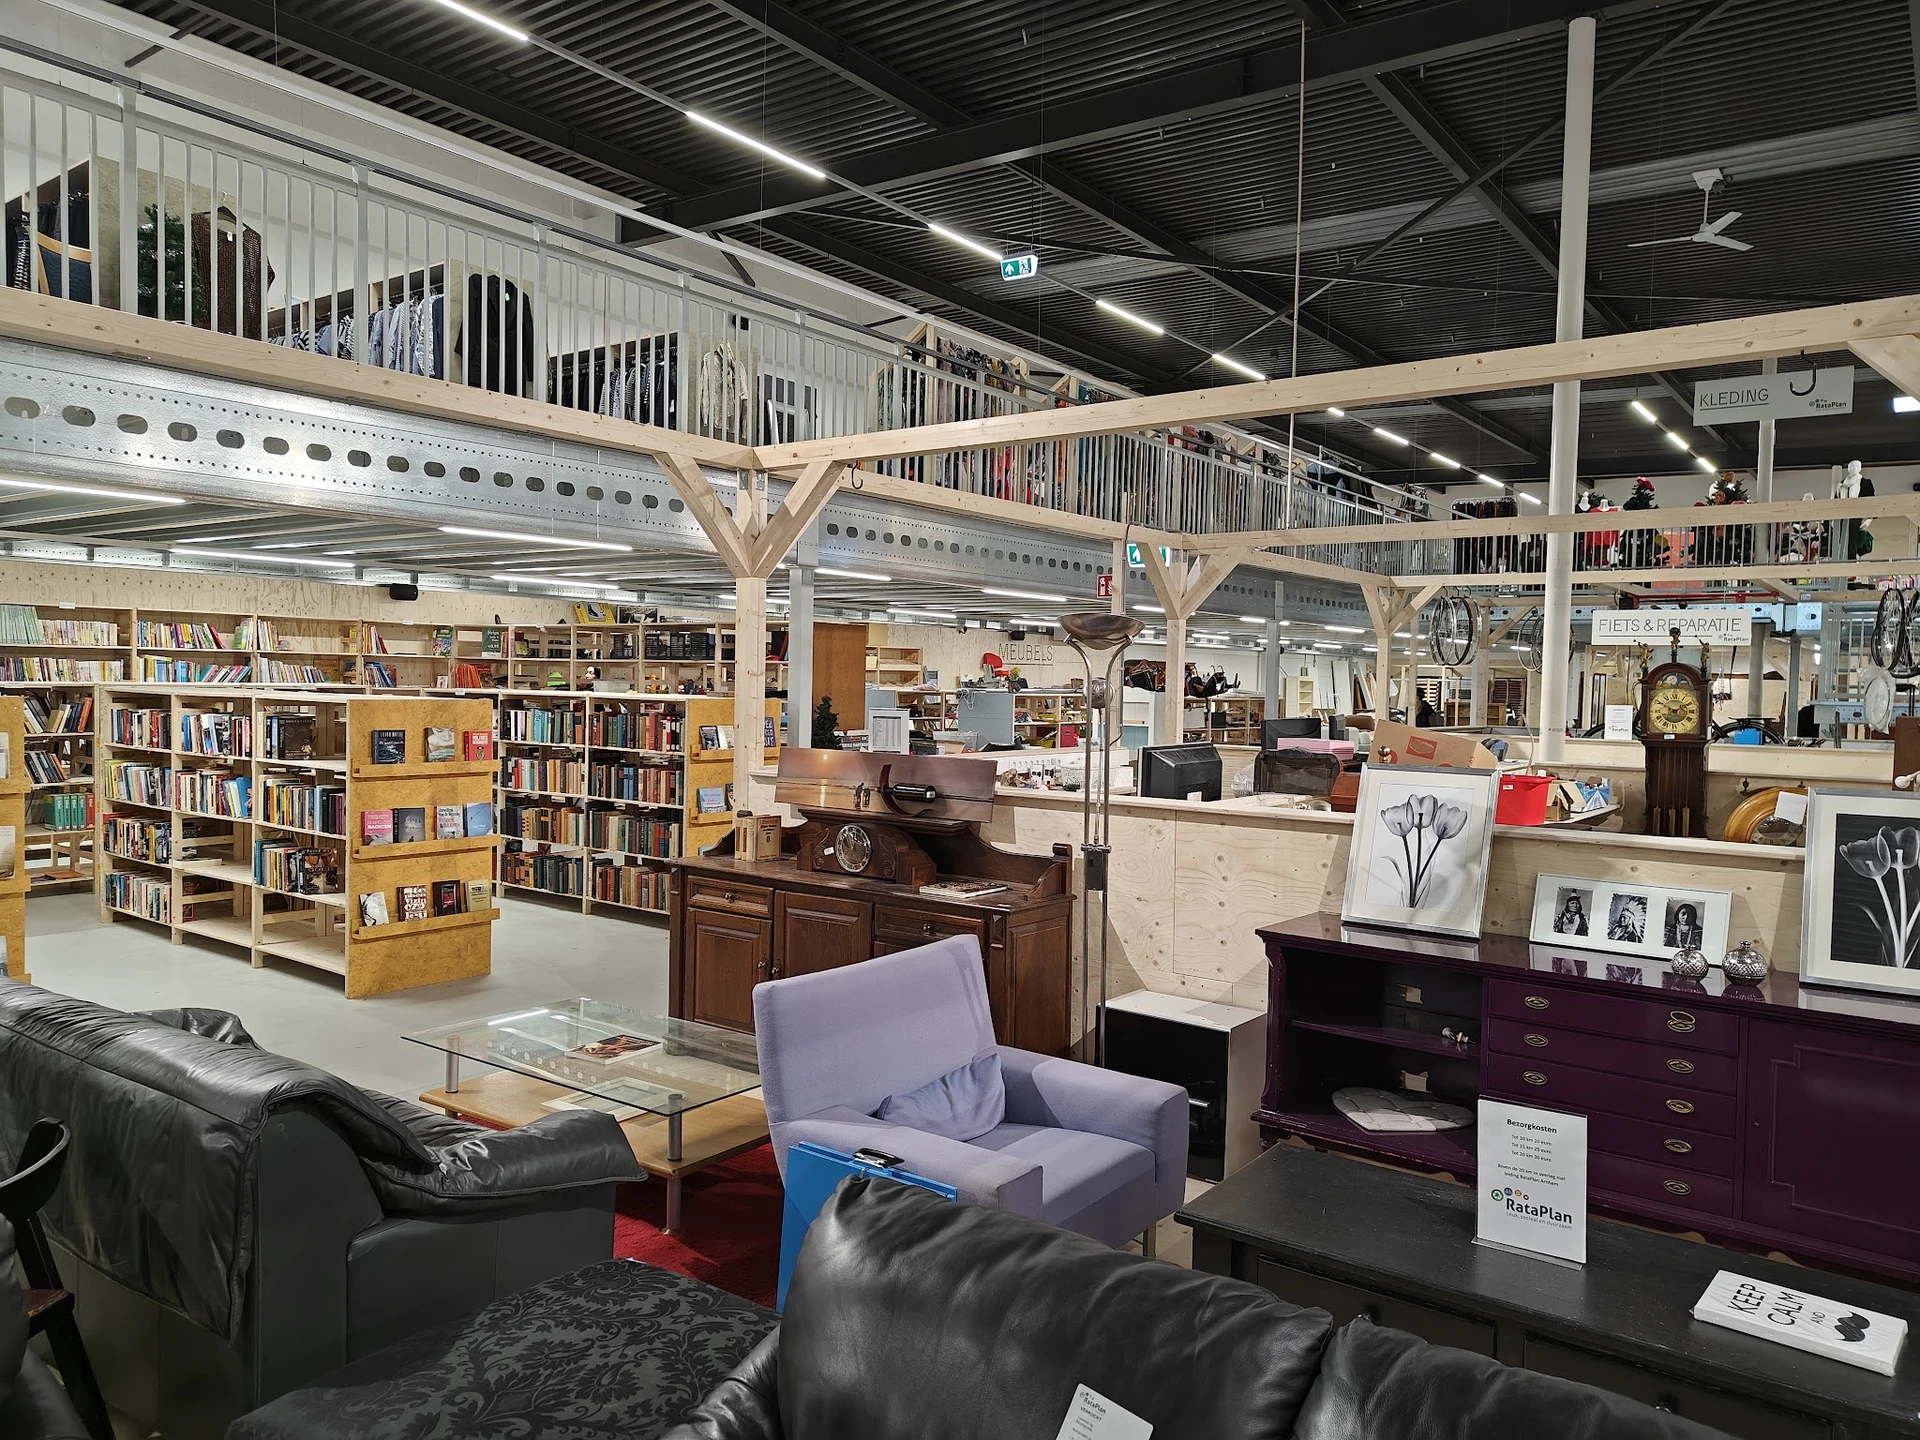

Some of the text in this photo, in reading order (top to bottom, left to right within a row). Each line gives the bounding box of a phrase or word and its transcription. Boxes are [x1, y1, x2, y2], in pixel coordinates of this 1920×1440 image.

[1699, 388, 1770, 408] KLEDING
[1815, 401, 1847, 409] RataPlan
[1598, 617, 1742, 632] FIETS & REPARATIE
[998, 643, 1053, 661] MEUBELS
[1507, 1119, 1557, 1134] Bezorgkosten
[1506, 1198, 1572, 1224] RataPlan
[1506, 1211, 1520, 1219] Leuk,
[1520, 1214, 1539, 1223] sociaal
[1546, 1220, 1572, 1230] duurzaam
[1727, 1283, 1766, 1315] KEEP
[1767, 1291, 1807, 1326] CALM
[1084, 1397, 1106, 1414] RataPlan
